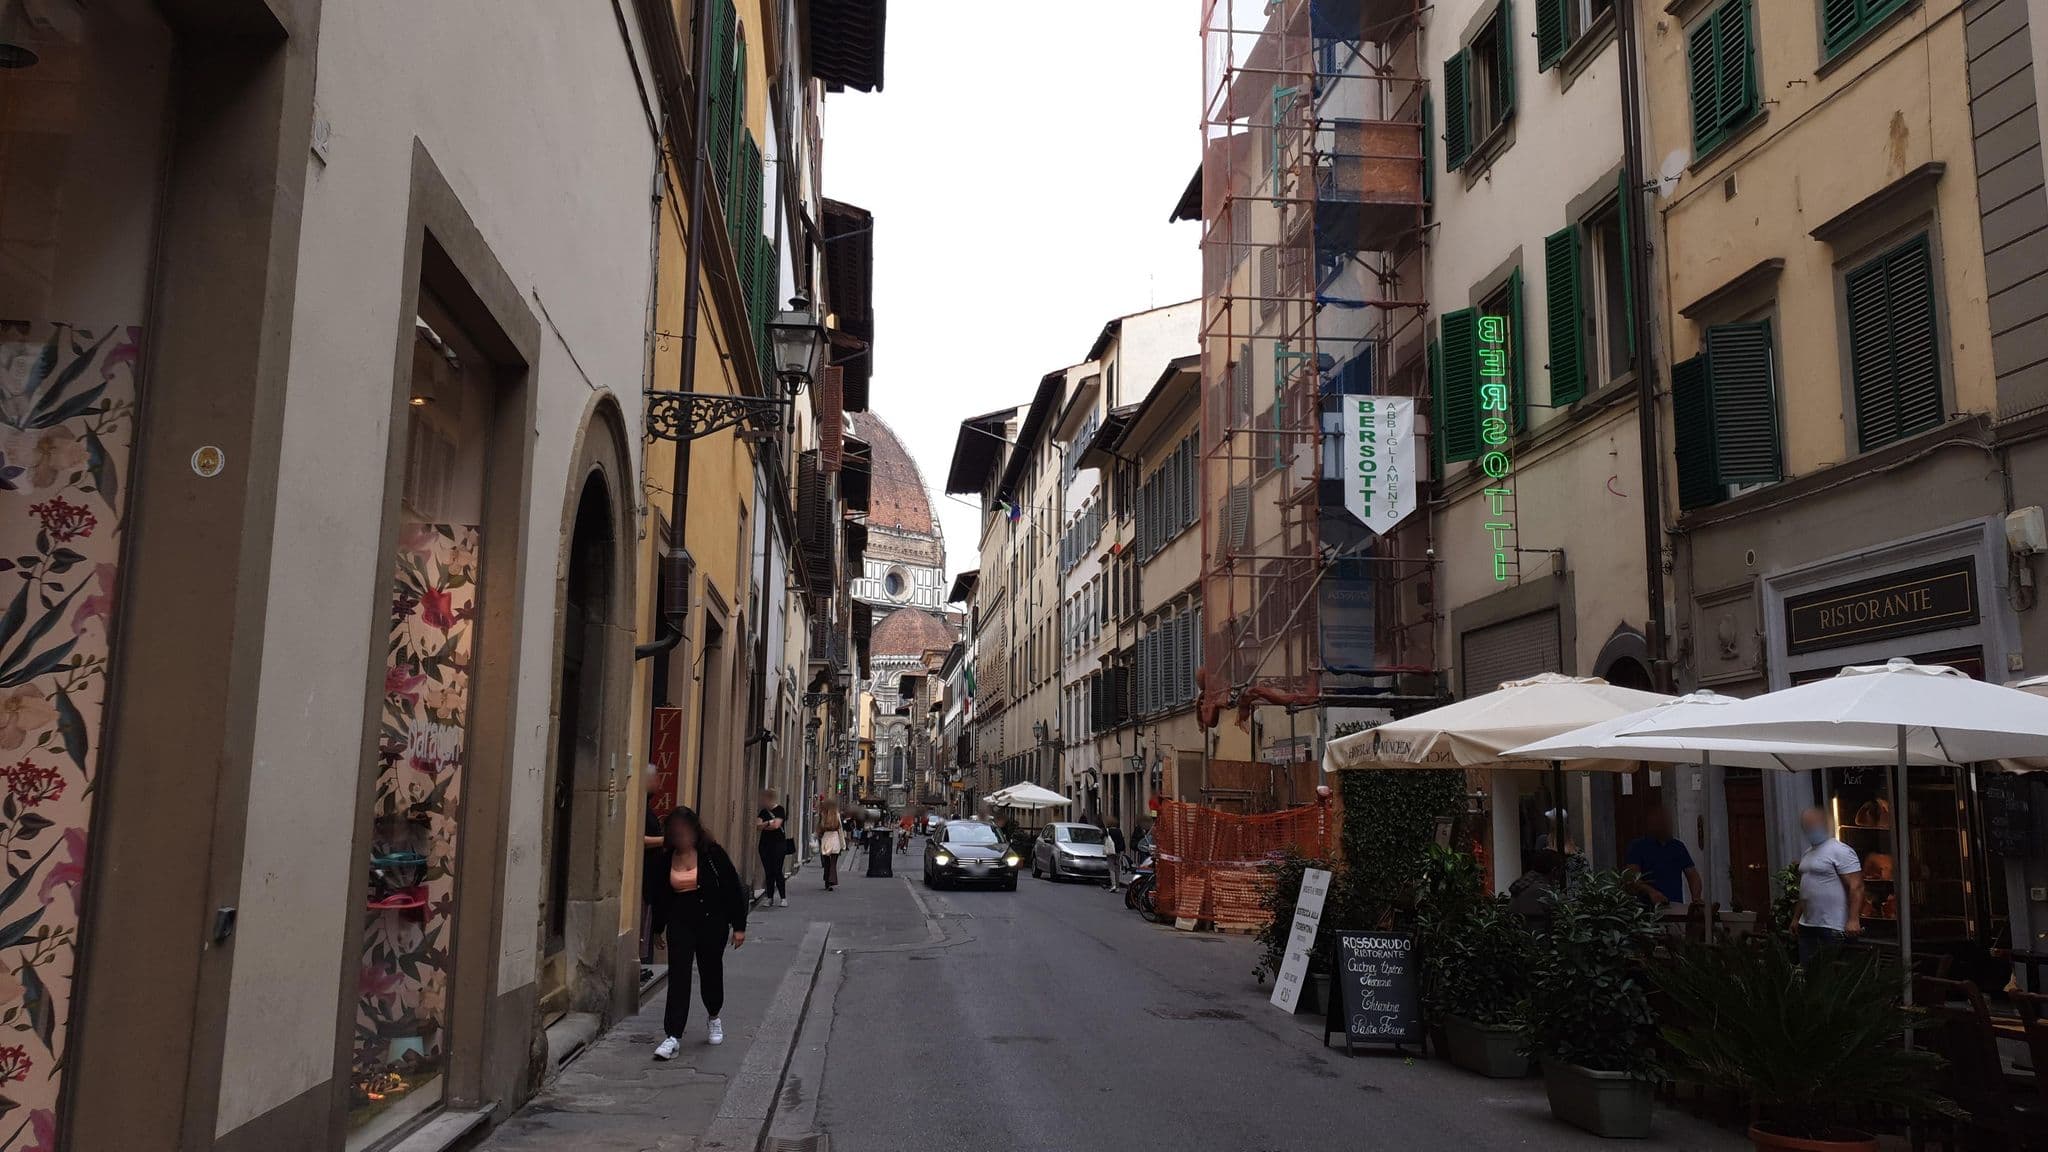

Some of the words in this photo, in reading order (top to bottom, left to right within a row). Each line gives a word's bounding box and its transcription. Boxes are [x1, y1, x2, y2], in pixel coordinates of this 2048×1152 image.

[1358, 401, 1377, 518] BERSOTTI
[1386, 402, 1399, 519] ABBIGLIAMENTO
[1819, 588, 1932, 630] RISTORANTE
[1342, 936, 1411, 951] ROSSOCRUDO
[1353, 948, 1406, 959] RISTORANTE
